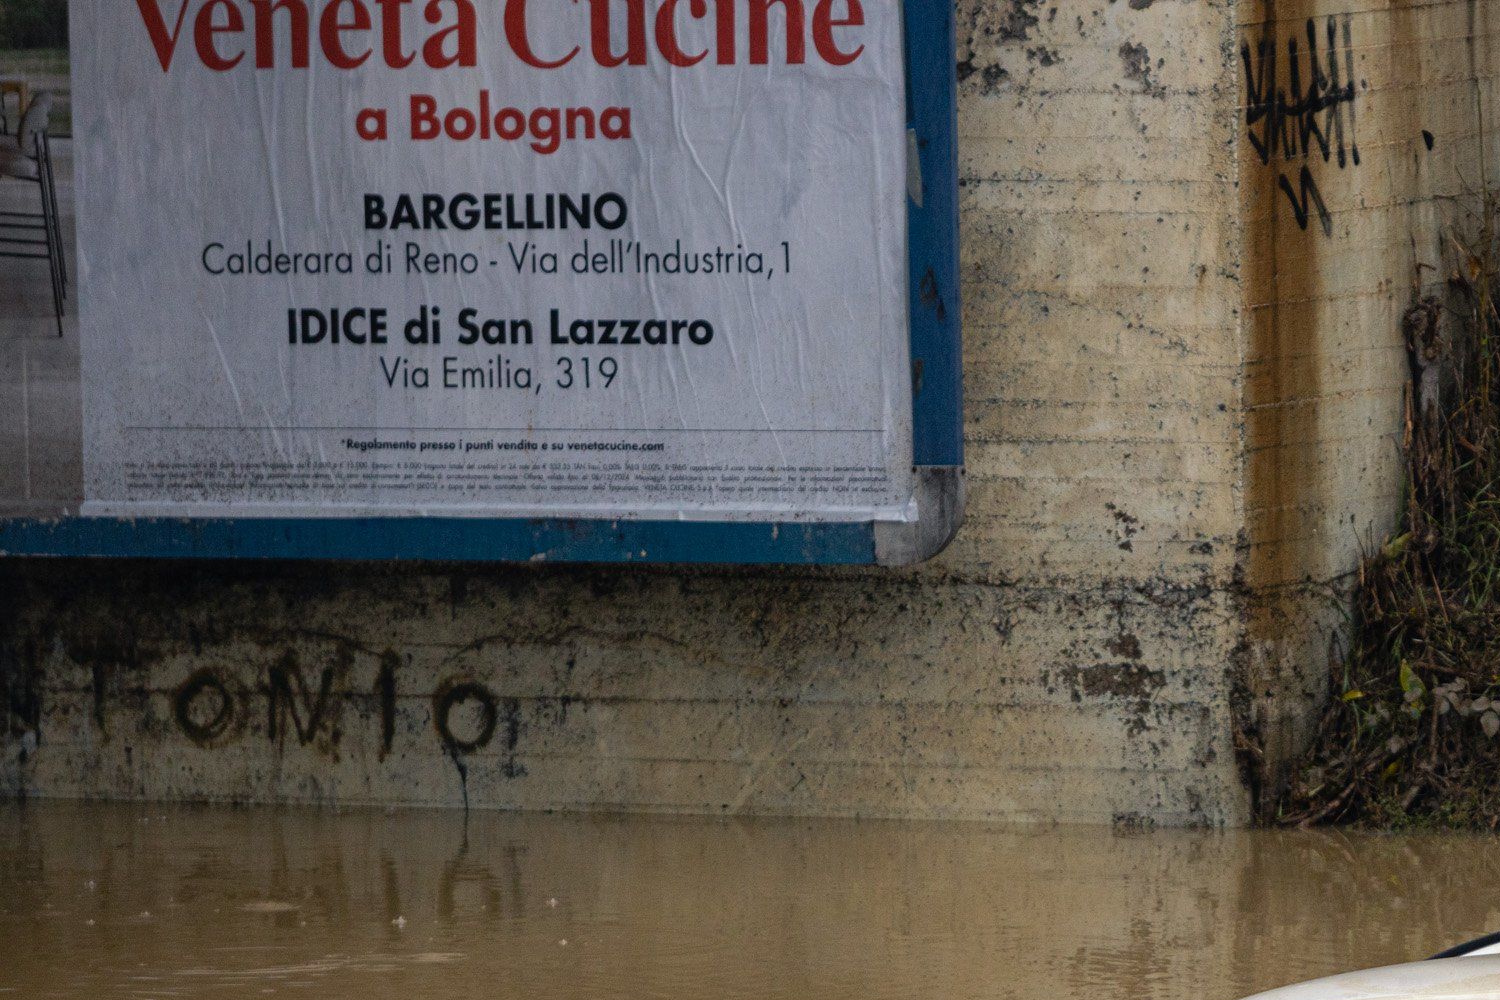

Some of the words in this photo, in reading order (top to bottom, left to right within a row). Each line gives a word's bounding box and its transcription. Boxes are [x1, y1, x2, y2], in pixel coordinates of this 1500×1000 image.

[136, 0, 478, 72] Veneta
[502, 0, 866, 69] Cucine
[356, 107, 389, 141] a
[409, 89, 632, 155] Bologna
[363, 192, 628, 231] BARGELLINO
[201, 239, 354, 276] Calderara
[364, 239, 392, 275] di
[404, 241, 479, 275] Reno
[507, 241, 558, 274] Via
[286, 306, 388, 345] IDICE
[403, 304, 441, 346] di
[457, 307, 534, 346] San
[549, 308, 715, 346] Lazzaro
[379, 355, 430, 389] Via
[442, 353, 543, 396] Emilia,
[556, 356, 620, 390] 319
[420, 440, 456, 454] presso
[465, 439, 494, 454] punti
[497, 439, 538, 452] vendita
[541, 442, 549, 451] e
[551, 442, 564, 452] su
[567, 440, 665, 453] venetacucine.com
